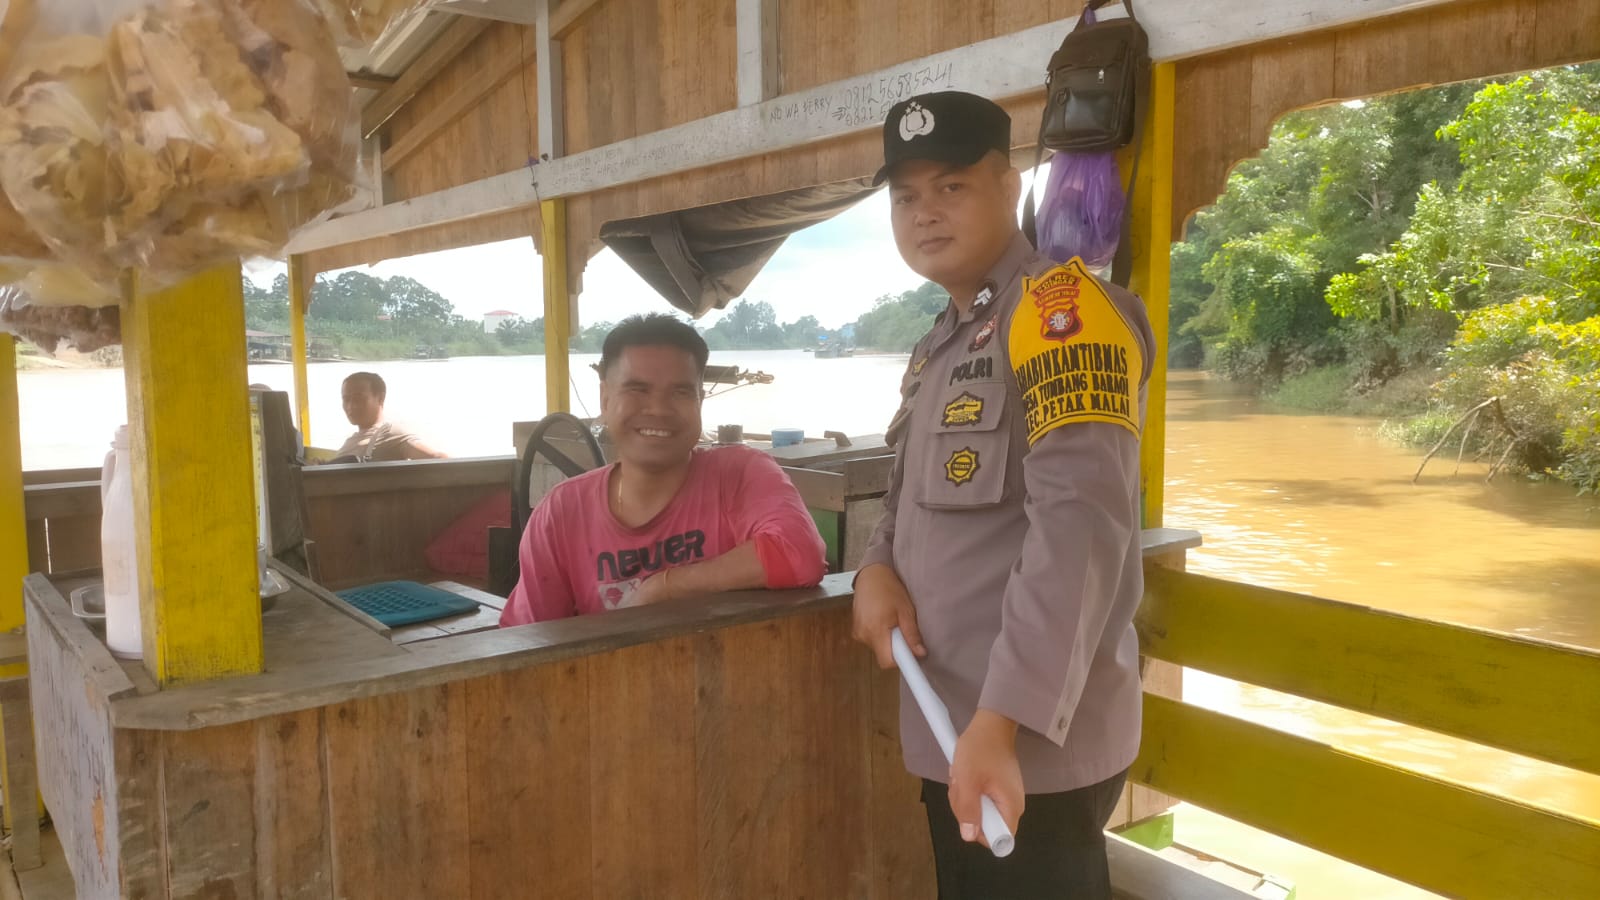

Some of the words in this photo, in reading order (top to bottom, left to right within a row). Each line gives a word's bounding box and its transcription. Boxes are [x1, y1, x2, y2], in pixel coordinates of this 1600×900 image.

[949, 356, 992, 386] POLRI
[1039, 372, 1088, 403] TUMBANG
[1090, 393, 1130, 418] MALAI
